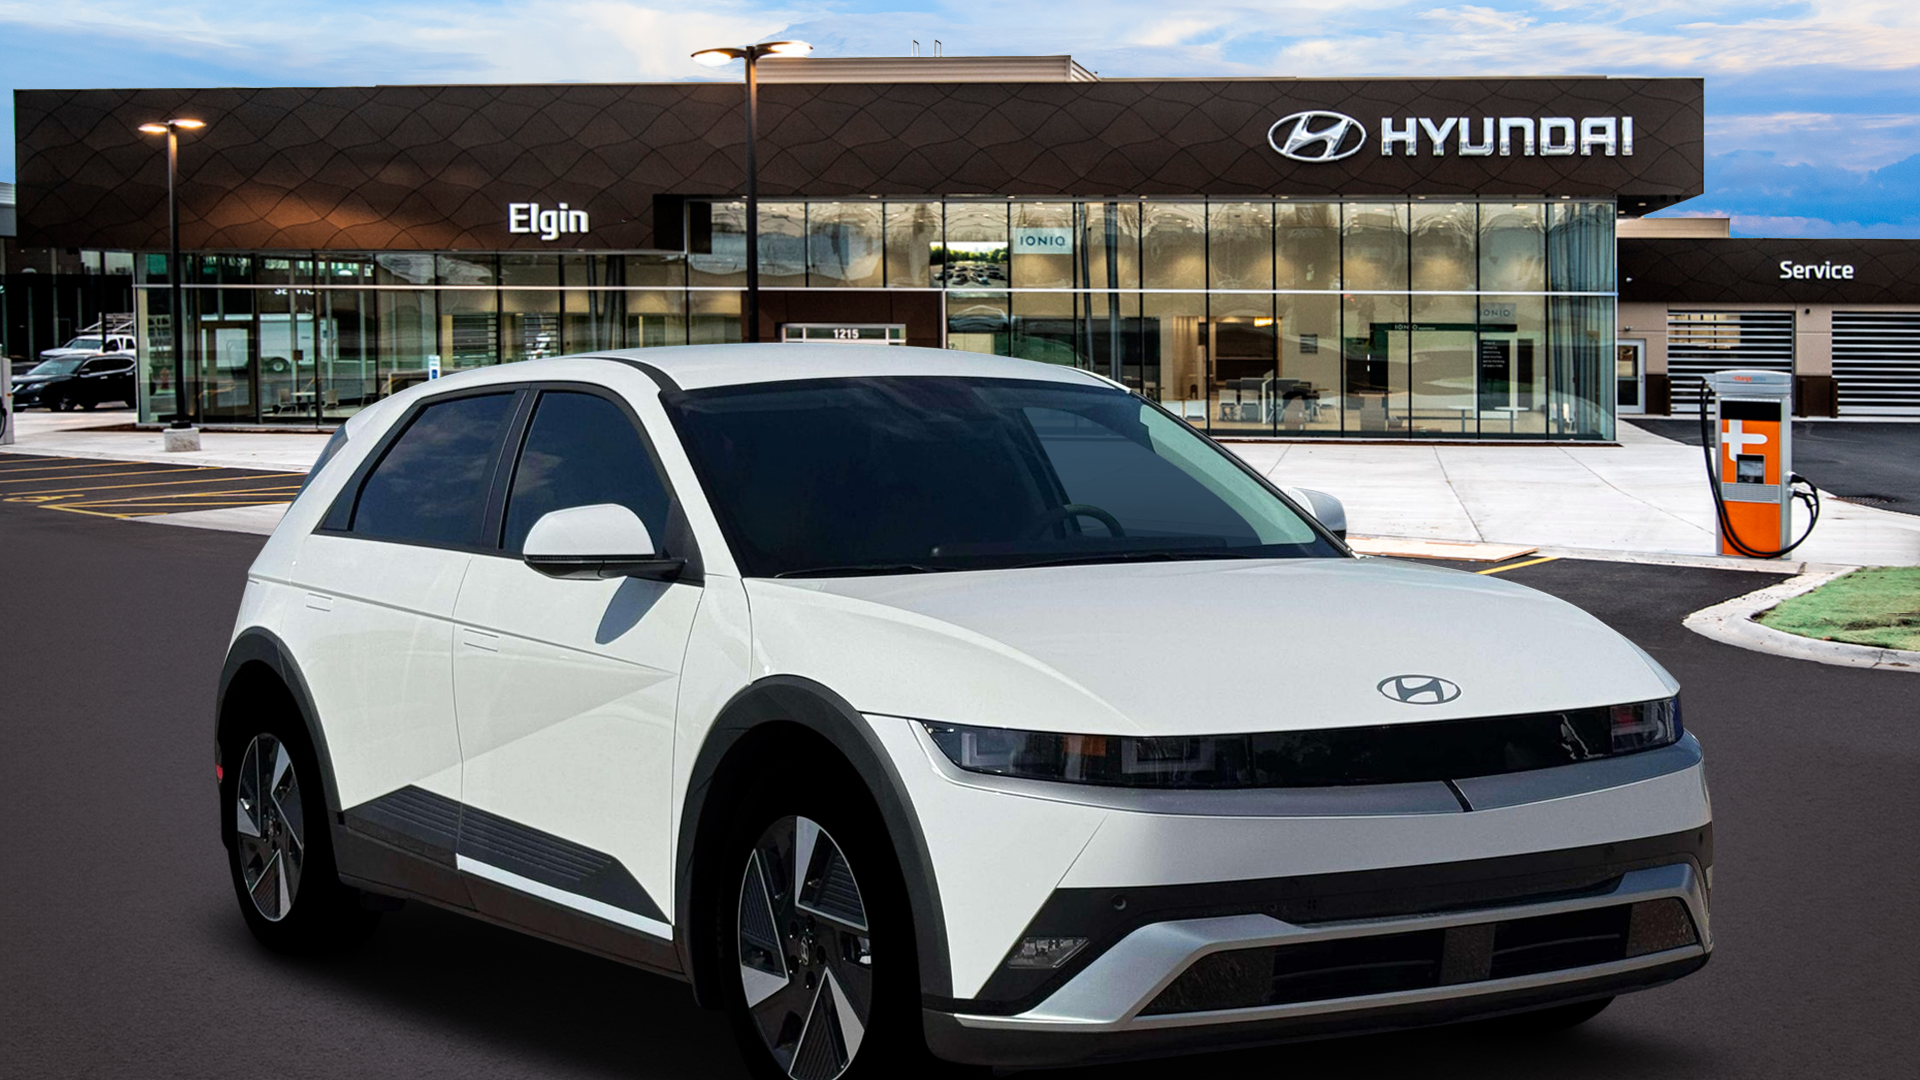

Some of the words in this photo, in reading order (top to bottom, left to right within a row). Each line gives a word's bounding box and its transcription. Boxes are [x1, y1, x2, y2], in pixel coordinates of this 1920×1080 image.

[1381, 117, 1633, 156] HYUNDAI
[508, 202, 589, 241] Elgin
[1020, 235, 1066, 246] IONIQ
[1779, 260, 1854, 279] Service
[833, 329, 859, 339] 1215
